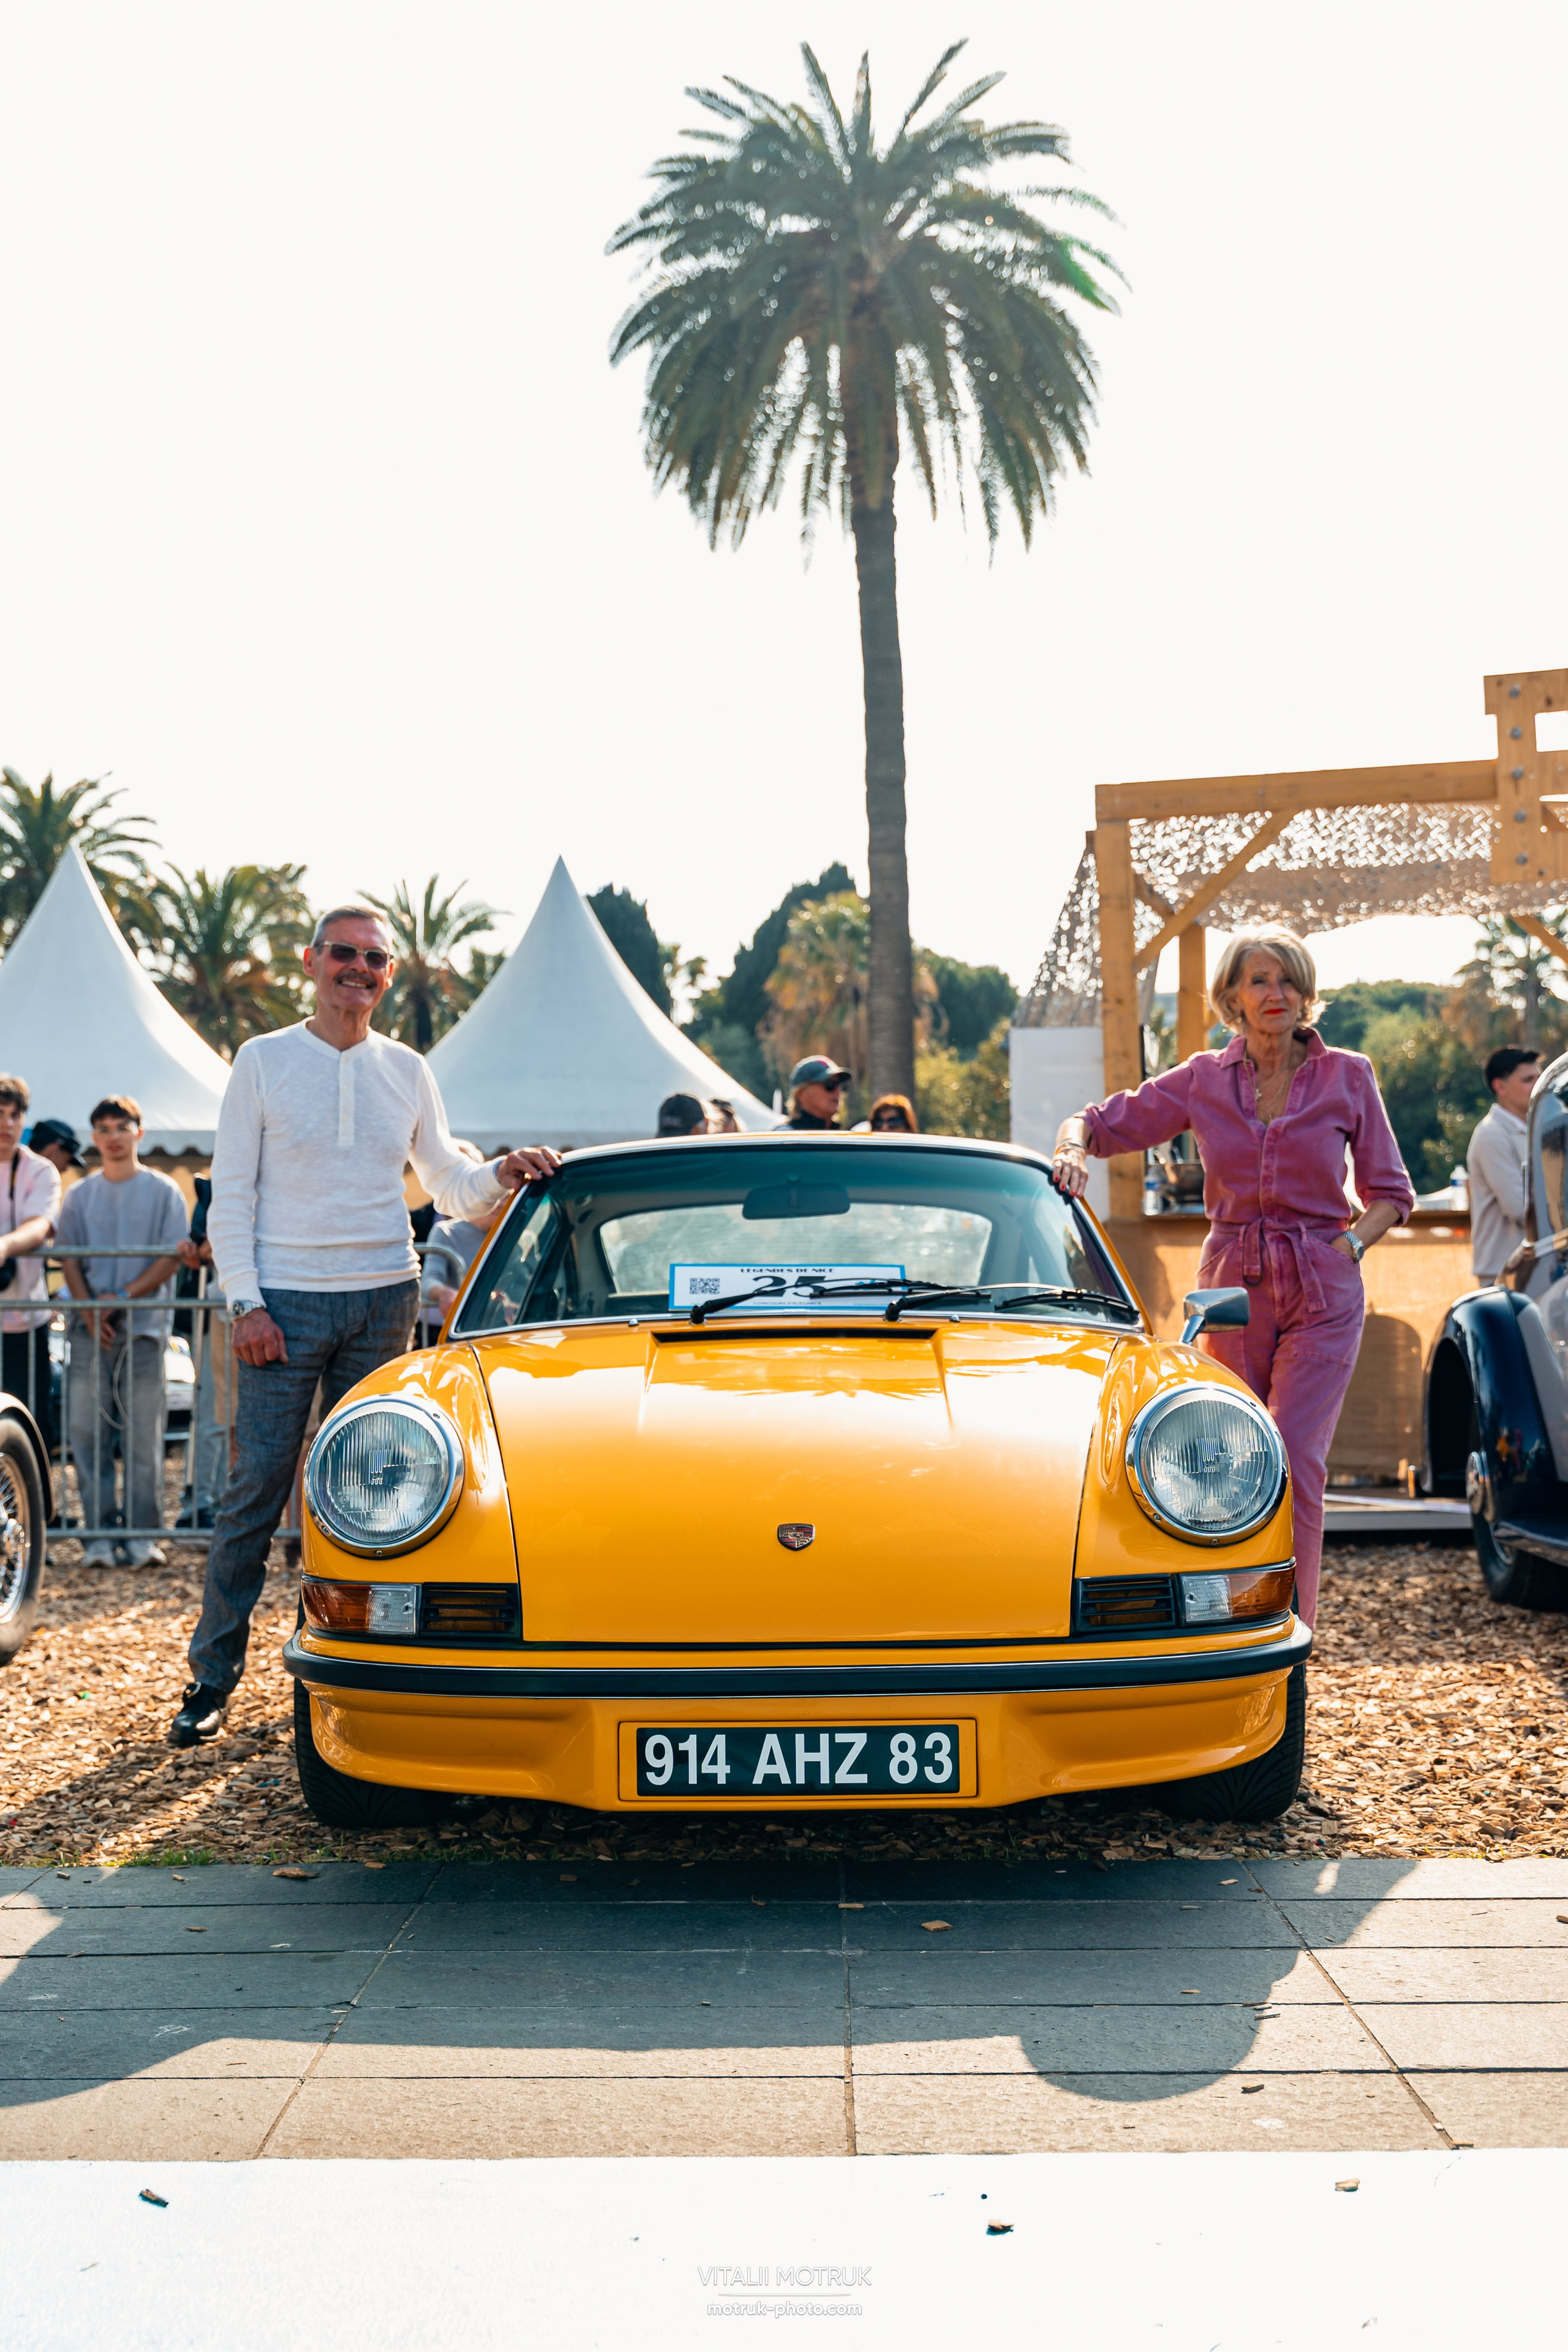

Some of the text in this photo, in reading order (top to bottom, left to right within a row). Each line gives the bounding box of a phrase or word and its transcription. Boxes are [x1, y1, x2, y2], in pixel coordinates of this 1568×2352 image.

[752, 1275, 826, 1297] 25
[644, 1732, 953, 1785] 914 AHZ 83
